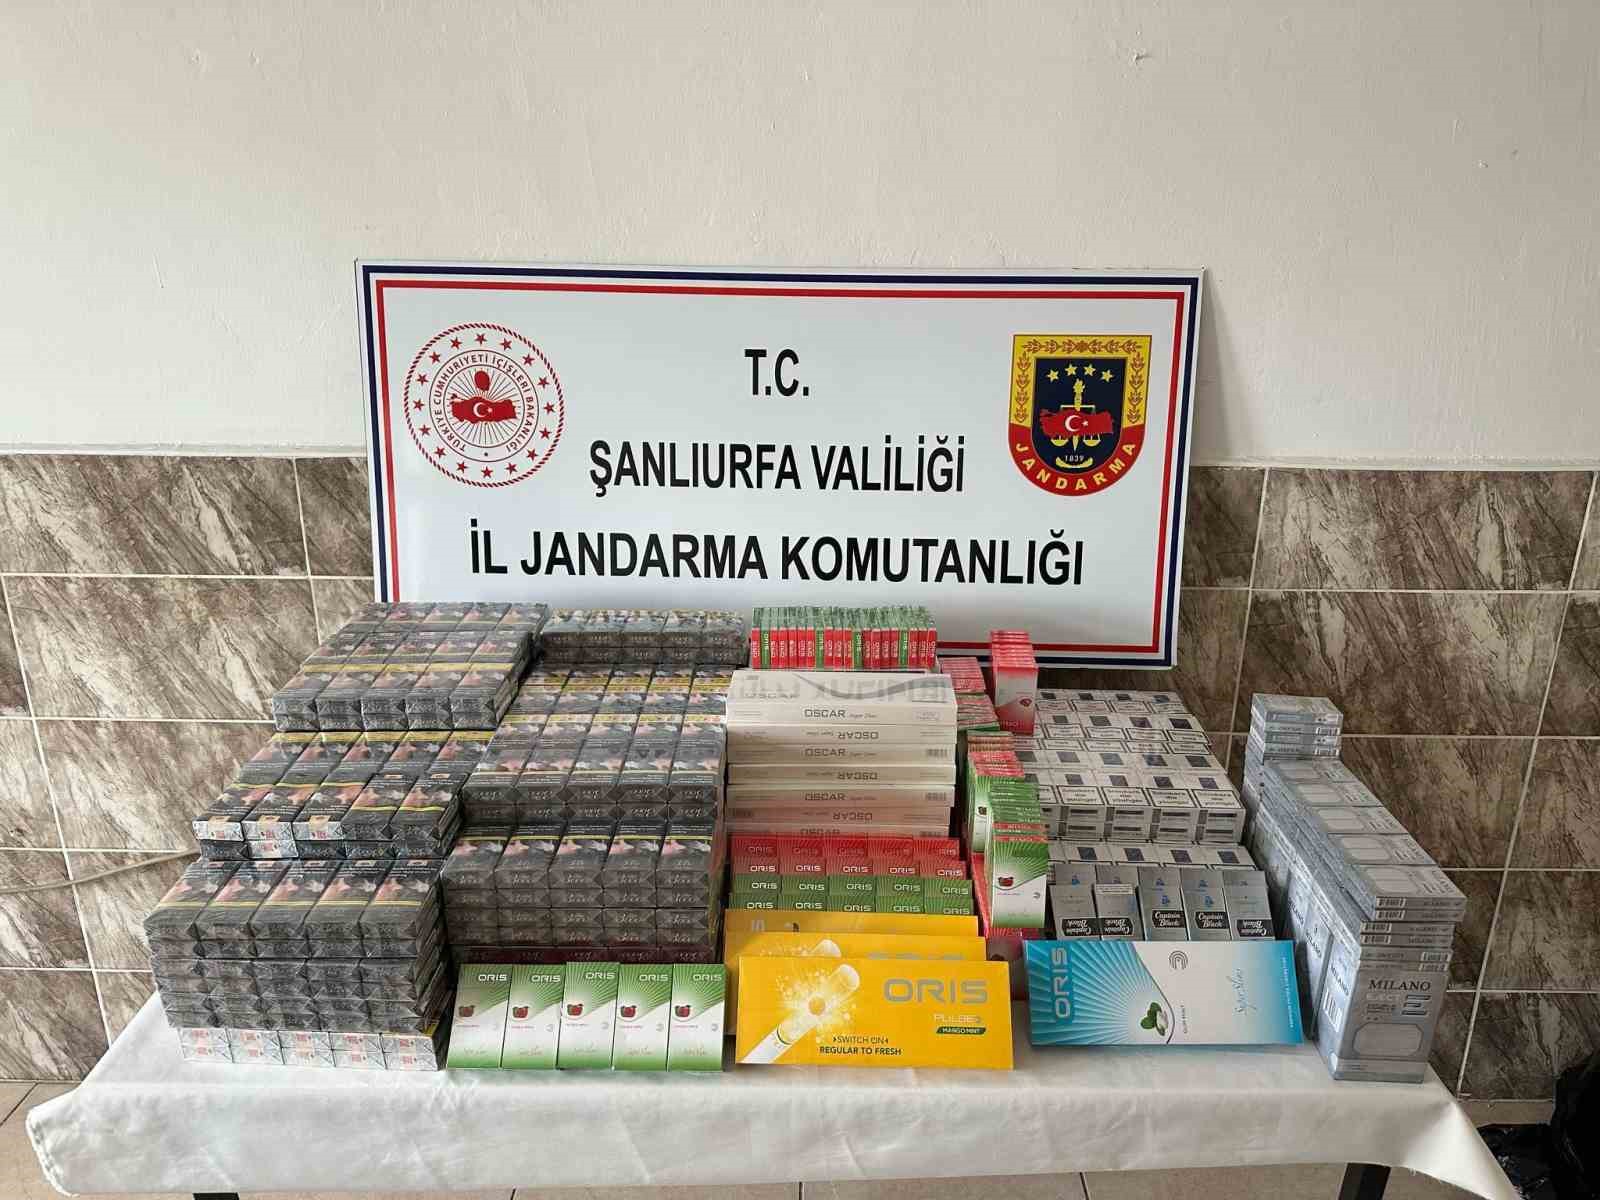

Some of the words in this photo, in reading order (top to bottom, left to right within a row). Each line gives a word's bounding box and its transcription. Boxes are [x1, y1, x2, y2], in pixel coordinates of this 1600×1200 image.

[492, 356, 529, 393] İÇİŞLERİ
[744, 349, 809, 396] T.C.
[434, 353, 488, 405] CUMHURİYETİ
[506, 396, 535, 453] BAKANLIĞI
[589, 440, 802, 498] ŞANLIURFA
[811, 435, 965, 492] VALİLİĞİ
[1016, 443, 1136, 490] JANDARMA
[470, 518, 508, 574] İL
[520, 531, 768, 580] JANDARMA
[781, 529, 1084, 585] KOMUTANLIĞI
[804, 709, 846, 718] OSCAR
[838, 731, 879, 740] OSCAR
[804, 748, 846, 757] OSCAR
[837, 772, 878, 780] OSCAR
[804, 792, 846, 801] OSCAR
[832, 812, 873, 821] OSCAR
[752, 882, 778, 890] ORIS
[799, 882, 825, 891] ORIS
[846, 882, 872, 891] ORIS
[894, 883, 921, 892] ORIS
[942, 886, 969, 895] ORIS
[843, 904, 872, 912] ORIS
[893, 904, 921, 912] ORIS
[1154, 911, 1181, 920] Captain
[1199, 912, 1223, 921] Captain
[477, 973, 508, 982] ORIS
[531, 974, 561, 983] ORIS
[585, 971, 616, 980] ORIS
[639, 973, 669, 982] ORIS
[692, 973, 722, 982] ORIS
[1053, 946, 1071, 1019] ORIS
[1368, 979, 1432, 992] MILANO
[884, 978, 988, 1004] ORIS
[837, 1036, 869, 1044] SWITCH
[870, 1037, 884, 1045] ON
[820, 1046, 858, 1055] REGULAR
[861, 1047, 873, 1055] TO
[875, 1047, 902, 1056] FRESH
